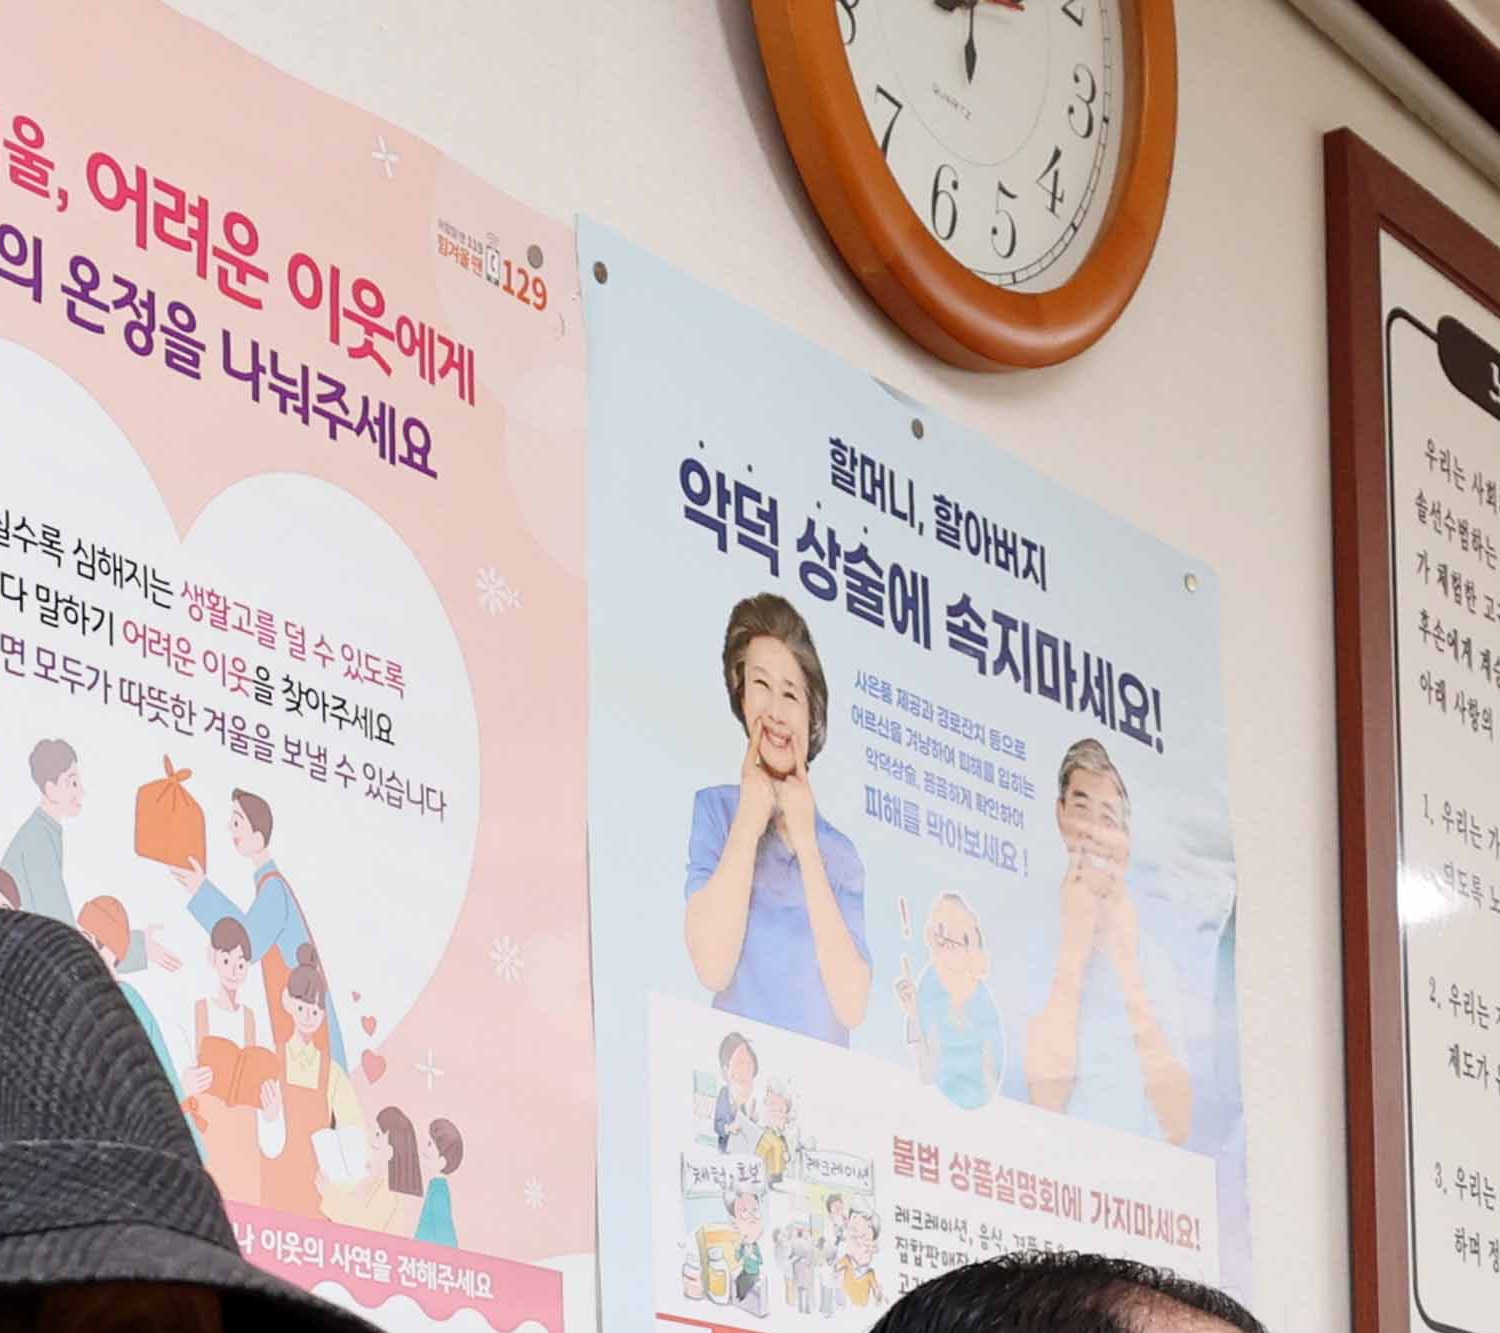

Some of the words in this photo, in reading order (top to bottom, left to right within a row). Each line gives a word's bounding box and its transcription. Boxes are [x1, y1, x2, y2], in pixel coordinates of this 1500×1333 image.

[874, 84, 903, 161] 7
[1068, 64, 1097, 139] 3
[930, 164, 959, 241] 6
[990, 180, 1018, 259] 5
[1036, 146, 1065, 218] 4
[86, 151, 270, 311] 어려운
[286, 250, 476, 407] 이웃에게
[502, 259, 548, 312] 129
[61, 253, 206, 379] 온정을
[222, 328, 439, 479] 나눠주세요
[1425, 438, 1464, 491] 우리는
[828, 436, 924, 537] 할머니,
[934, 493, 1047, 591] 할아버지
[72, 537, 175, 610] 심해지는
[180, 579, 278, 648] 생활고를
[283, 621, 307, 661] 덜
[311, 636, 335, 672] 수
[340, 643, 405, 699] 있도록
[680, 457, 780, 578] 악덕
[796, 515, 932, 651] 상술에
[945, 592, 1165, 755] 속지마세요!
[35, 583, 116, 647] 말하기
[122, 619, 197, 679] 어려운
[203, 648, 274, 707] 이웃을
[281, 673, 396, 747] 찾아주세요
[34, 646, 112, 706] 모두가
[119, 675, 197, 738] 따뜻한
[203, 704, 275, 765] 겨울을
[283, 733, 328, 783] 보낼
[334, 752, 357, 786] 수
[363, 760, 447, 822] 있습니다
[852, 704, 902, 744] 어르신을
[855, 670, 893, 705] 사은품
[989, 729, 1027, 761] 등으로
[864, 784, 920, 836] 피해를
[1441, 801, 1482, 851] 우리는
[1448, 983, 1490, 1030] 우리는
[1448, 1043, 1489, 1091] 제도가
[892, 1135, 941, 1185] 불법
[948, 1149, 1083, 1223] 상품설명회에
[1089, 1189, 1203, 1253] 가지마세요!
[1455, 1165, 1495, 1211] 우리는
[260, 1228, 324, 1266] 이웃의
[330, 1244, 391, 1283] 사연을
[397, 1254, 494, 1300] 전해주세요
[1454, 1227, 1481, 1268] 하며
